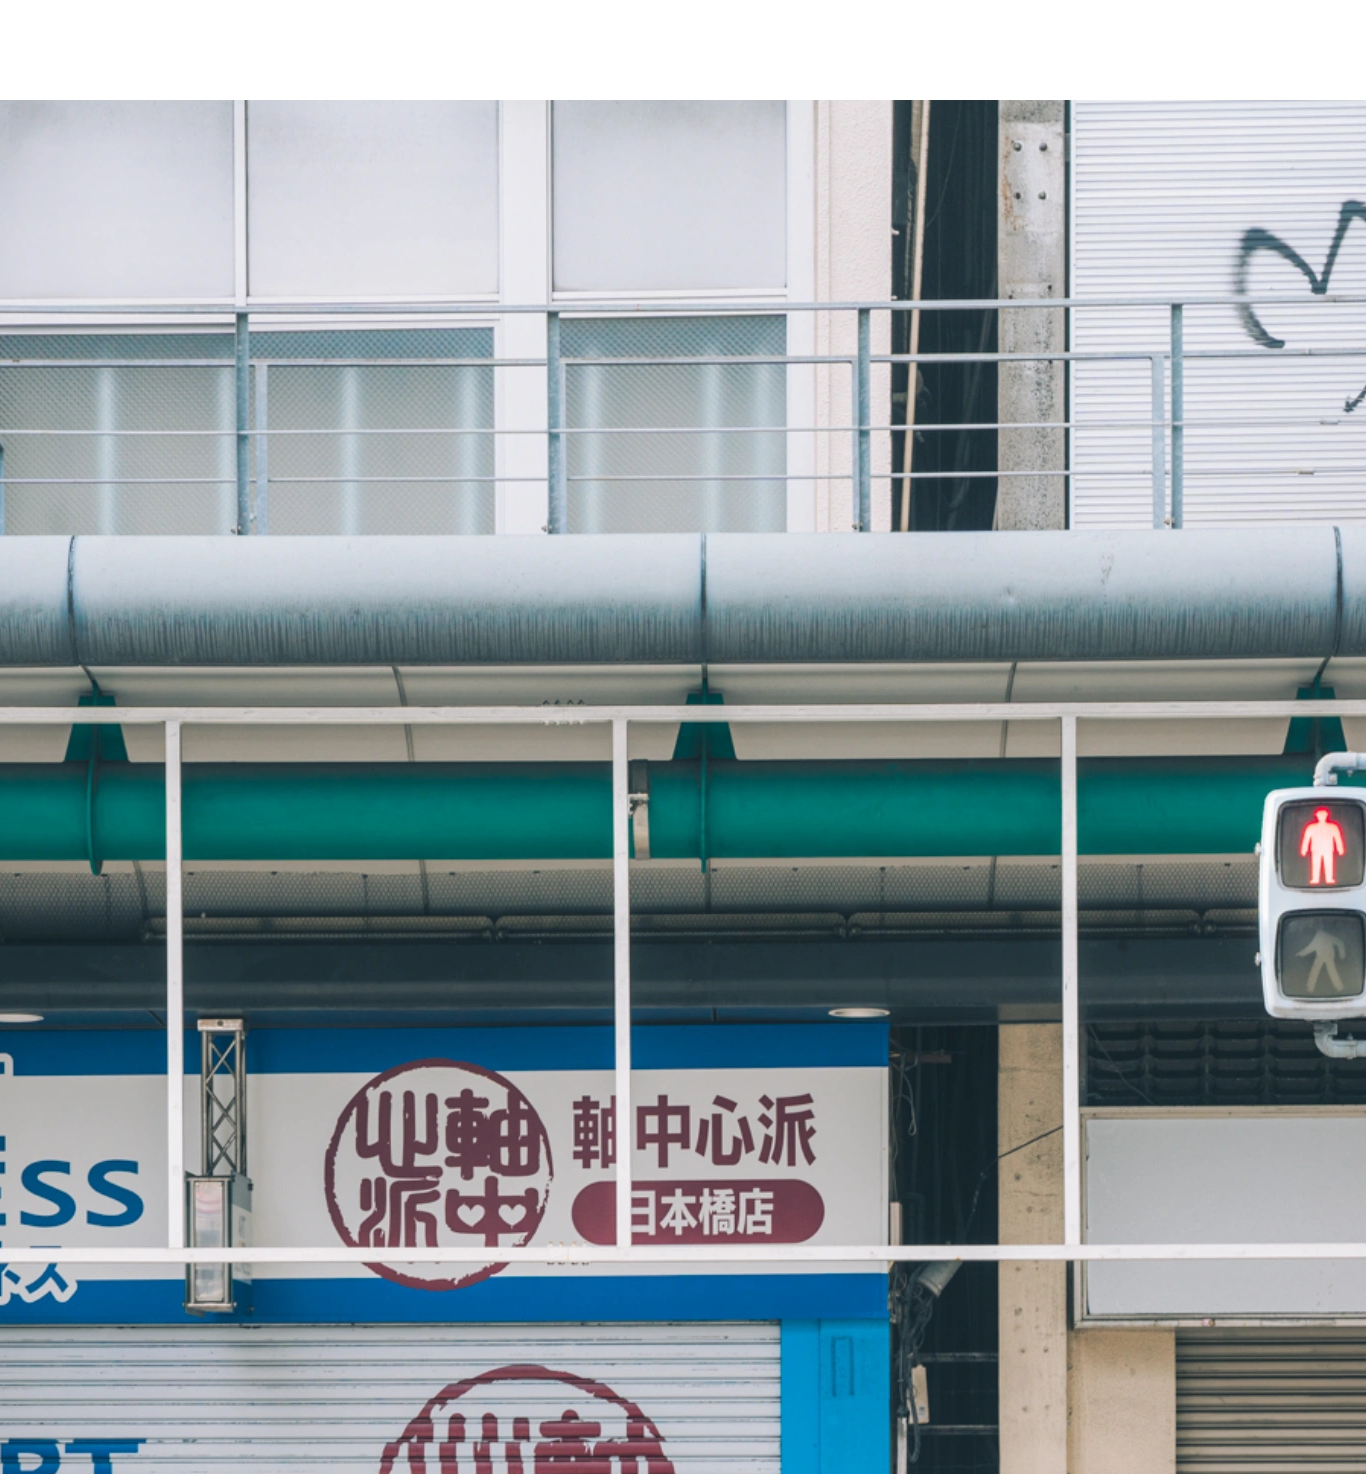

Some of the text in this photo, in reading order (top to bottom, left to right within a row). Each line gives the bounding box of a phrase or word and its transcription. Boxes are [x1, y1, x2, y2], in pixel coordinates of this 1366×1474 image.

[572, 1093, 817, 1169] 軸中心派
[630, 1187, 776, 1237] 日本橋店
